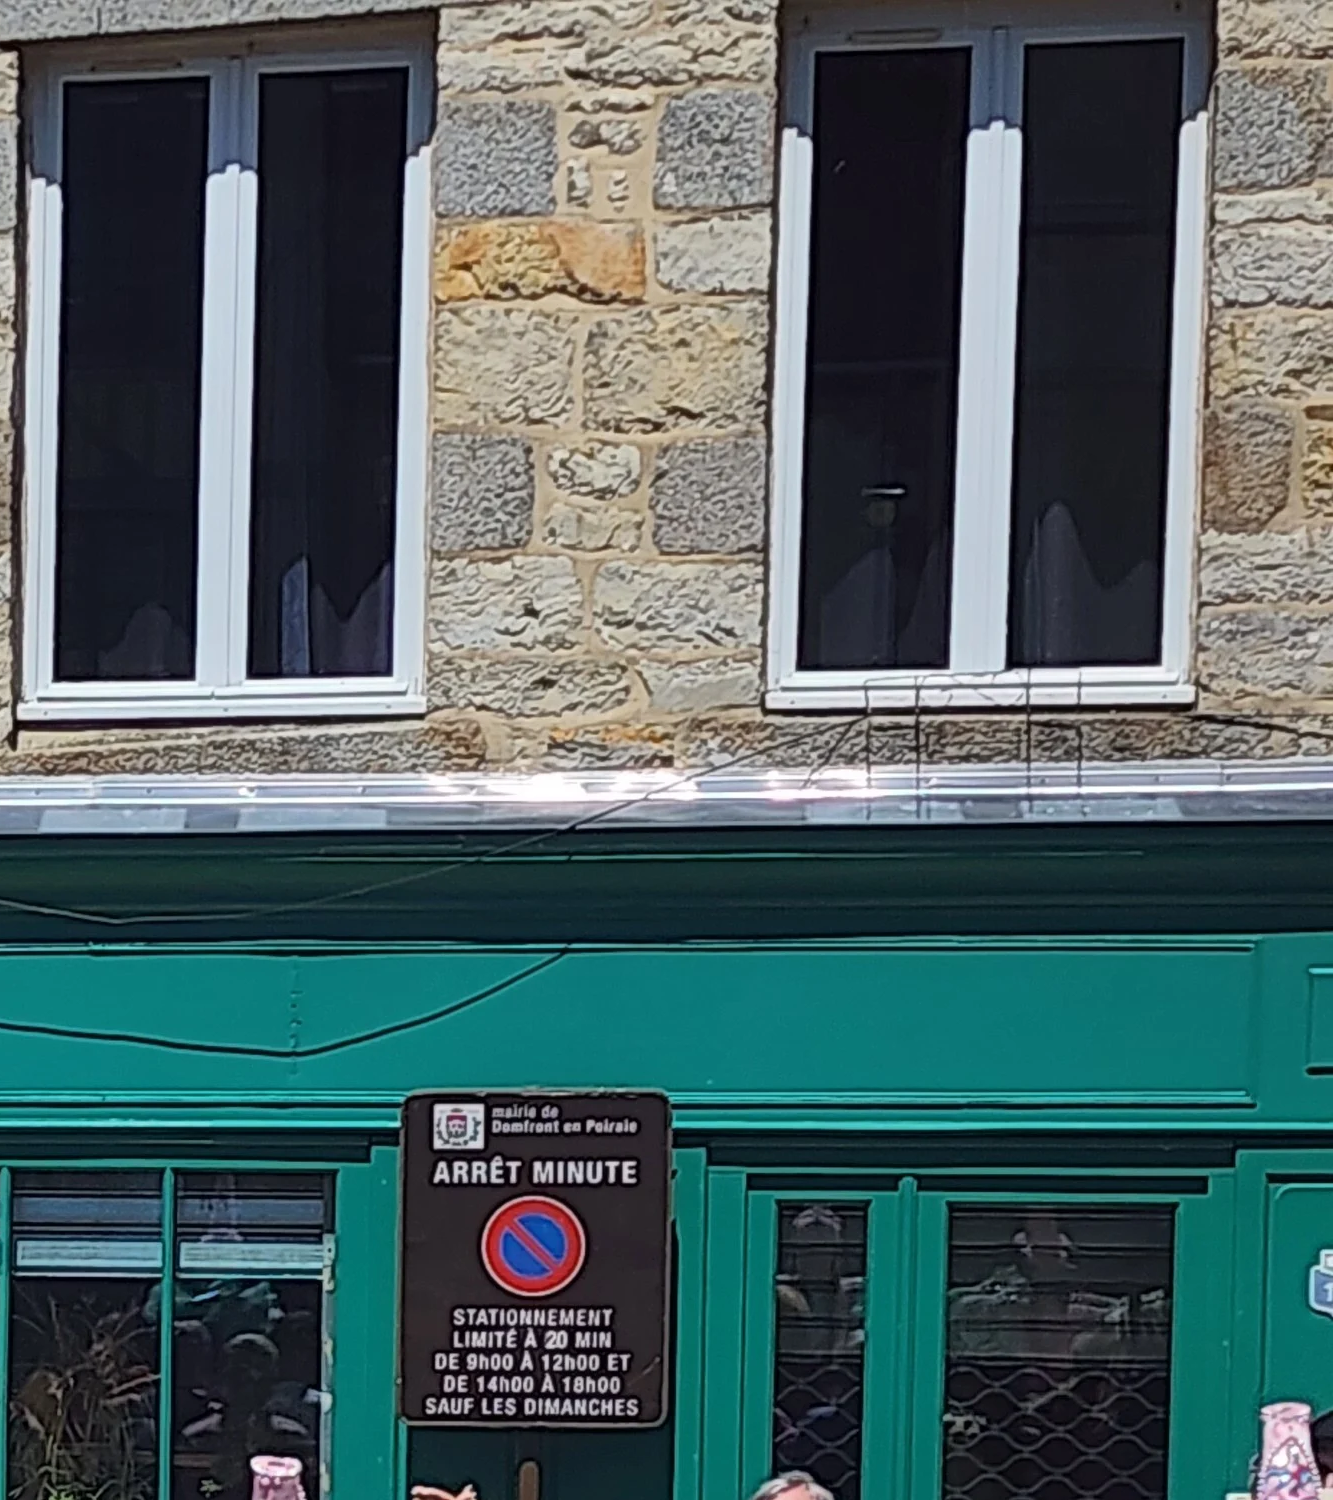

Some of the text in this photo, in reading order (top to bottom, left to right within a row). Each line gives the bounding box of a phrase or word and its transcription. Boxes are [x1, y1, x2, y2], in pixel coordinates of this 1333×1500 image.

[492, 1104, 559, 1118] mairie de
[492, 1119, 638, 1133] Domfront en Poiraie
[433, 1155, 637, 1184] ARRÊT MINUTE
[453, 1308, 613, 1326] STATIONNEMENT
[453, 1328, 612, 1349] LIMITÉ À 20 MIN
[435, 1350, 631, 1371] DE 9h00 À 12h00 ET
[443, 1373, 621, 1394] DE 14h00 À 18h00
[425, 1397, 639, 1416] SAUF LES DIMANCHES
